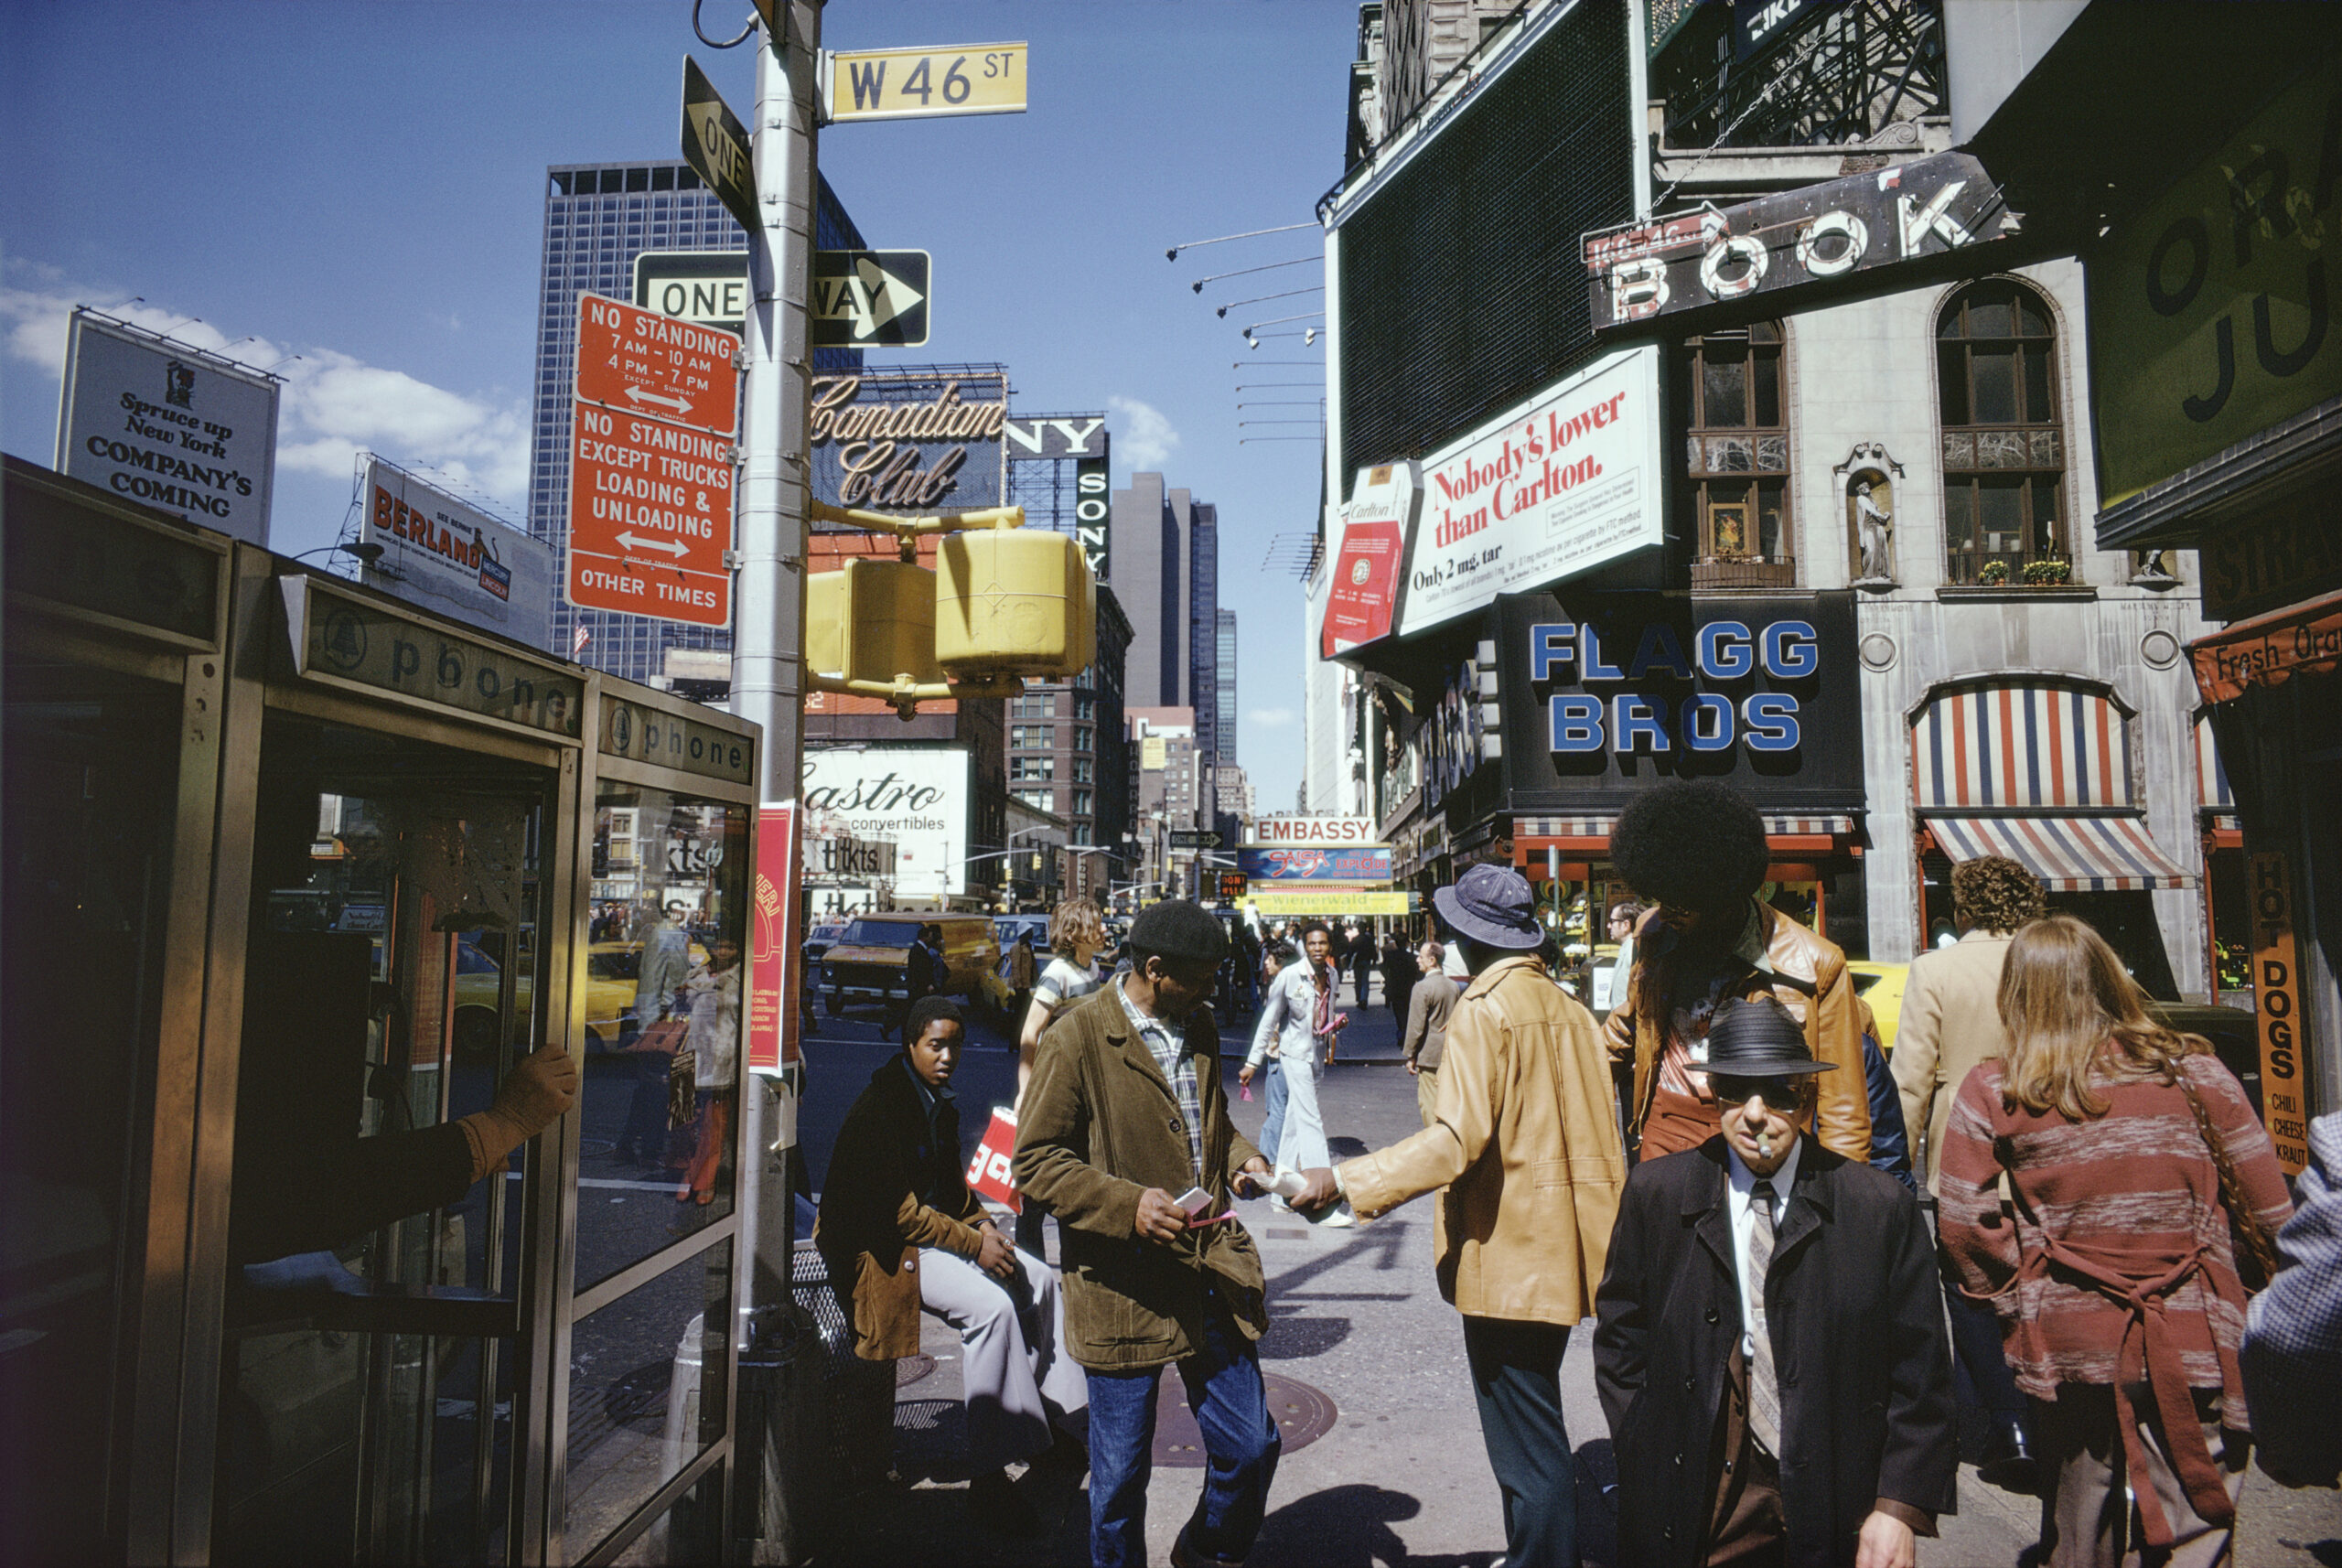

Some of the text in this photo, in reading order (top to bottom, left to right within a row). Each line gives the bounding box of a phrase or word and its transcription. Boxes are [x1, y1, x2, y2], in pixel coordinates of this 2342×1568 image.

[850, 52, 1014, 111] W 46 ST
[705, 116, 745, 192] ONE
[1613, 180, 1974, 321] BOOK
[662, 282, 745, 317] ONE
[591, 303, 730, 359] NO STANDING
[611, 333, 621, 349] 7
[624, 339, 648, 356] AM
[669, 349, 683, 366] 10
[688, 357, 711, 372] AM
[608, 354, 618, 370] 4
[625, 360, 648, 375] PM
[671, 369, 680, 384] 7
[687, 375, 709, 392] PM
[624, 373, 695, 397] EXCEPT SUNDAY
[120, 392, 232, 443] Spruce up
[811, 377, 1006, 440] Canadian
[124, 414, 227, 459] New York
[585, 410, 726, 463] NO STANDING
[1433, 422, 1544, 512] Nobody's
[1547, 391, 1626, 456] lower
[86, 435, 252, 497] COMPANY'S
[579, 438, 729, 489] EXCEPT TRUCKS
[840, 440, 966, 505] Club
[110, 472, 231, 518] COMING
[596, 469, 710, 513] LOADING &
[1350, 502, 1390, 520] Carlton
[1434, 454, 1603, 549] than Carlton.
[373, 484, 481, 571] BERLAND
[436, 511, 448, 524] SEE
[593, 497, 713, 539] UNLOADING
[1077, 472, 1107, 575] SONY
[581, 569, 716, 607] OTHER TIMES
[1413, 564, 1443, 591] Only
[1446, 558, 1454, 580] 2
[1482, 544, 1503, 564] tar
[1530, 620, 1820, 682] FLAGG
[2217, 624, 2342, 681] Fresh Ora
[392, 638, 567, 720] phone
[645, 722, 742, 769] phone
[1549, 693, 1801, 754] BROS
[851, 816, 945, 831] convertibles
[1259, 820, 1371, 840] EMBASSY
[1269, 850, 1330, 878] SALSA
[1336, 855, 1388, 871] EXPLODE
[2256, 862, 2286, 949] HOT
[2262, 961, 2295, 1079] DOGS
[2272, 1092, 2296, 1114] CHILI
[2273, 1117, 2305, 1143] CHEESE
[2275, 1141, 2306, 1167] KRAUT
